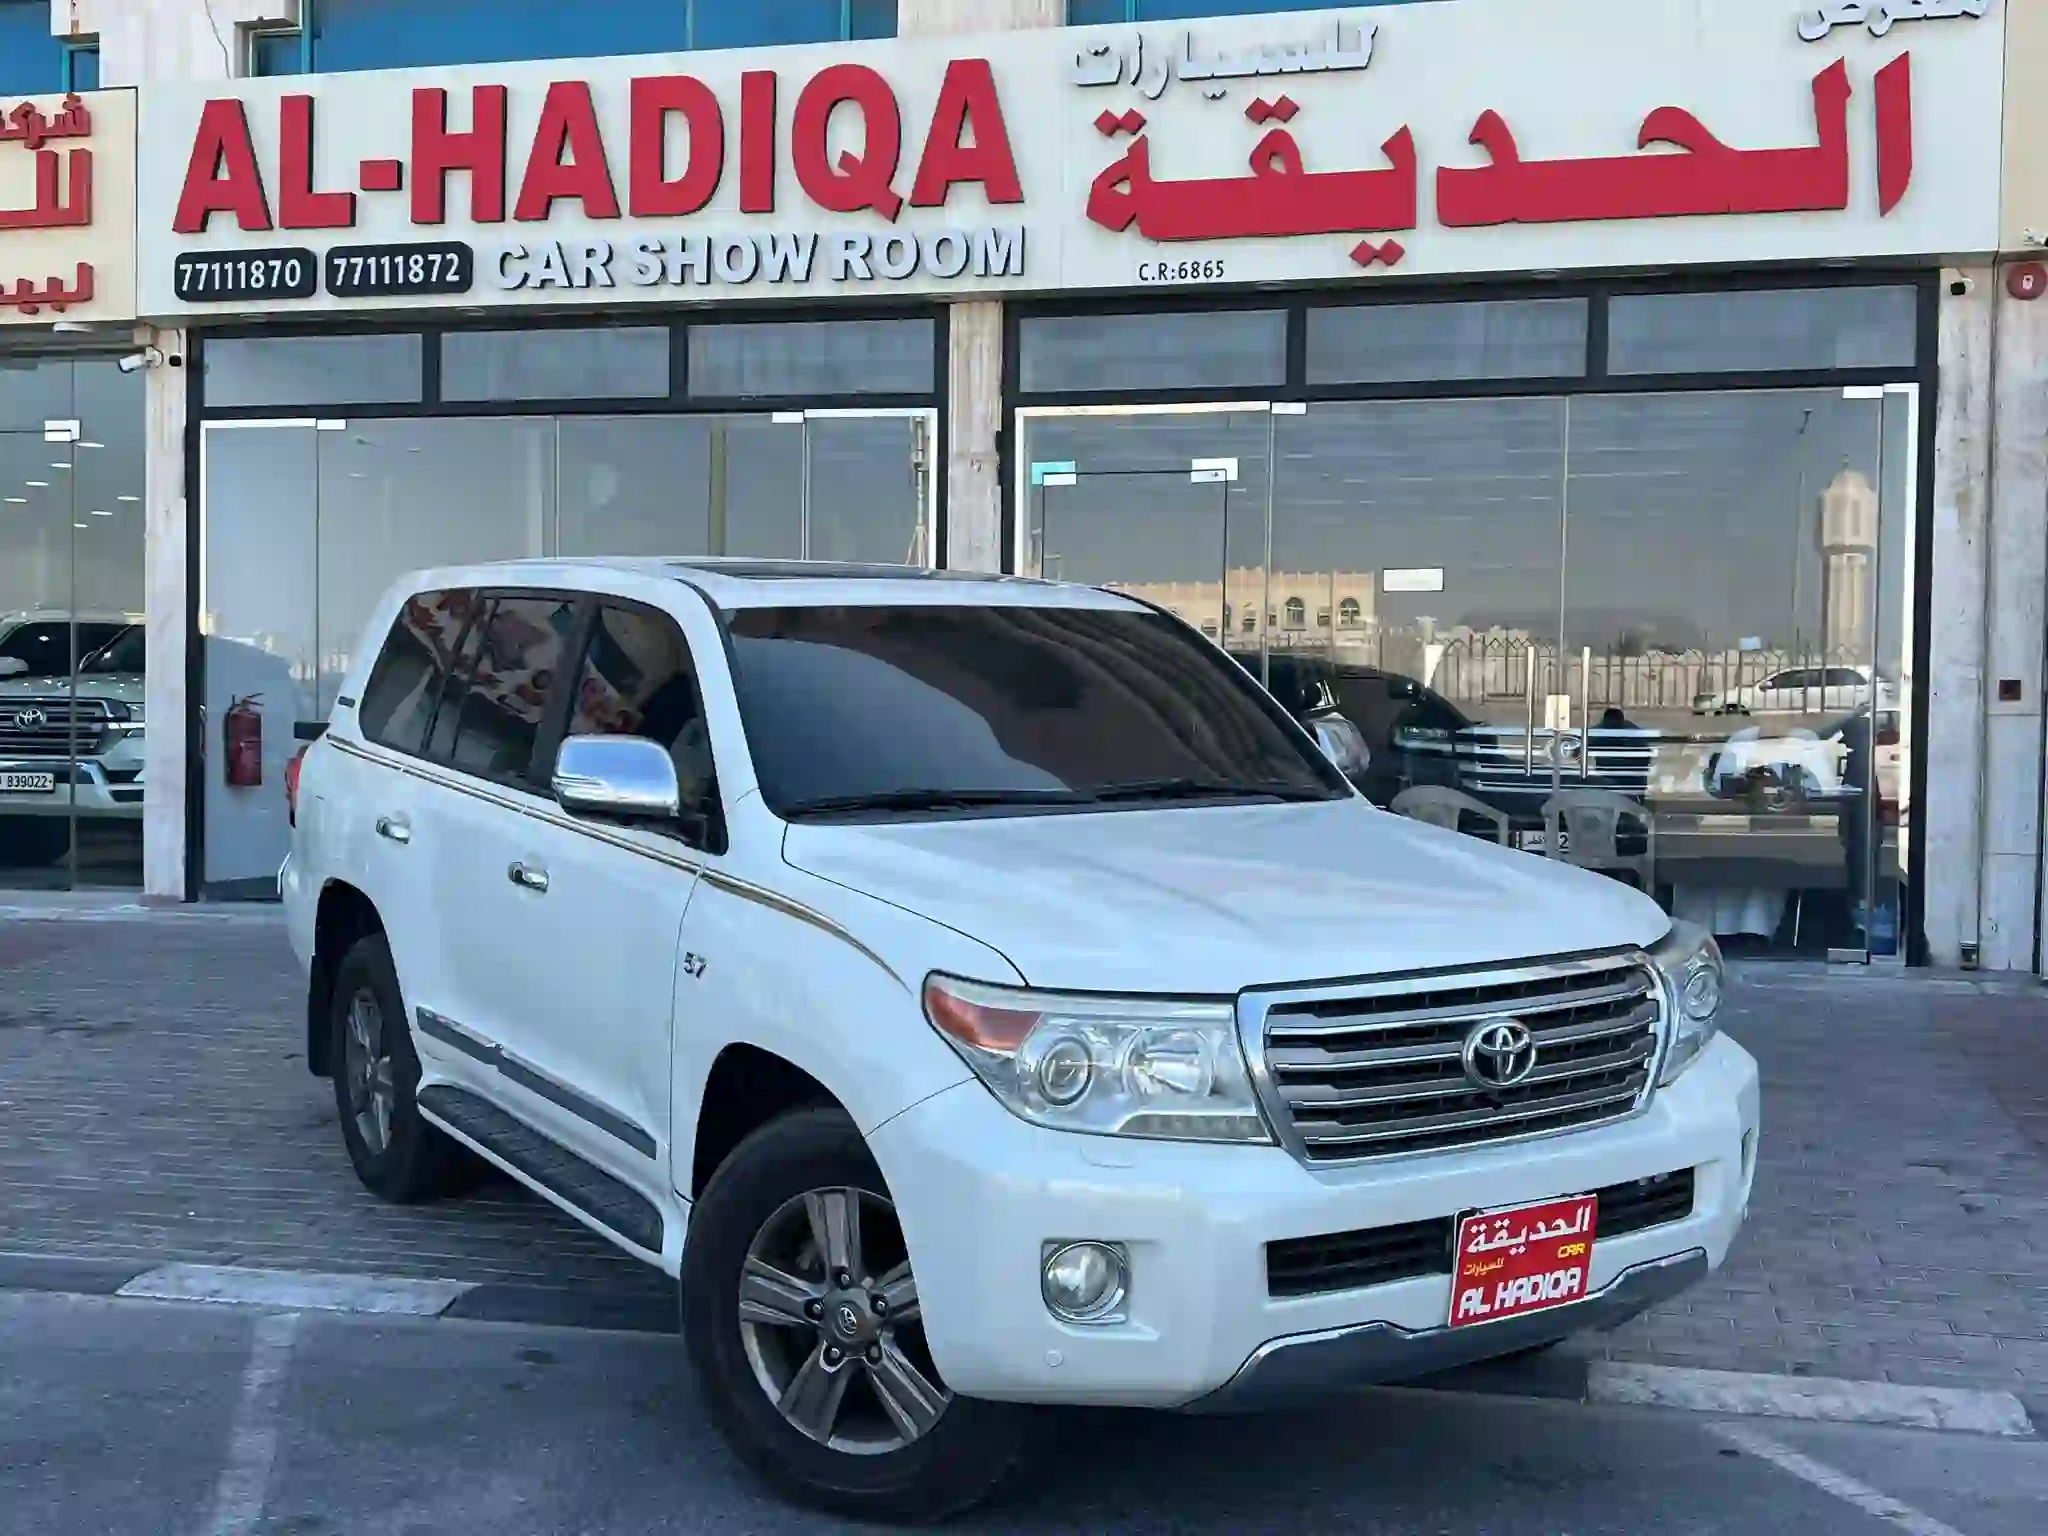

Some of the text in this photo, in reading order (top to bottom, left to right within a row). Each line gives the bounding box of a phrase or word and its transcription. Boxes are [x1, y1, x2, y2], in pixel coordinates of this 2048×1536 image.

[1071, 14, 1379, 100] للسيارات
[173, 58, 1024, 233] AL-HADIQA
[1085, 50, 1912, 267] الحديقة
[179, 252, 461, 291] 77111870 77111872
[497, 224, 1026, 289] CAR SHOW ROOM
[1139, 260, 1225, 281] C.R:6865
[7, 775, 48, 789] 839022
[1465, 1204, 1592, 1256] الحديقة
[1557, 1242, 1586, 1258] CAR
[1457, 1266, 1582, 1319] AL HADIQA
[1463, 1258, 1505, 1276] للسيارات
